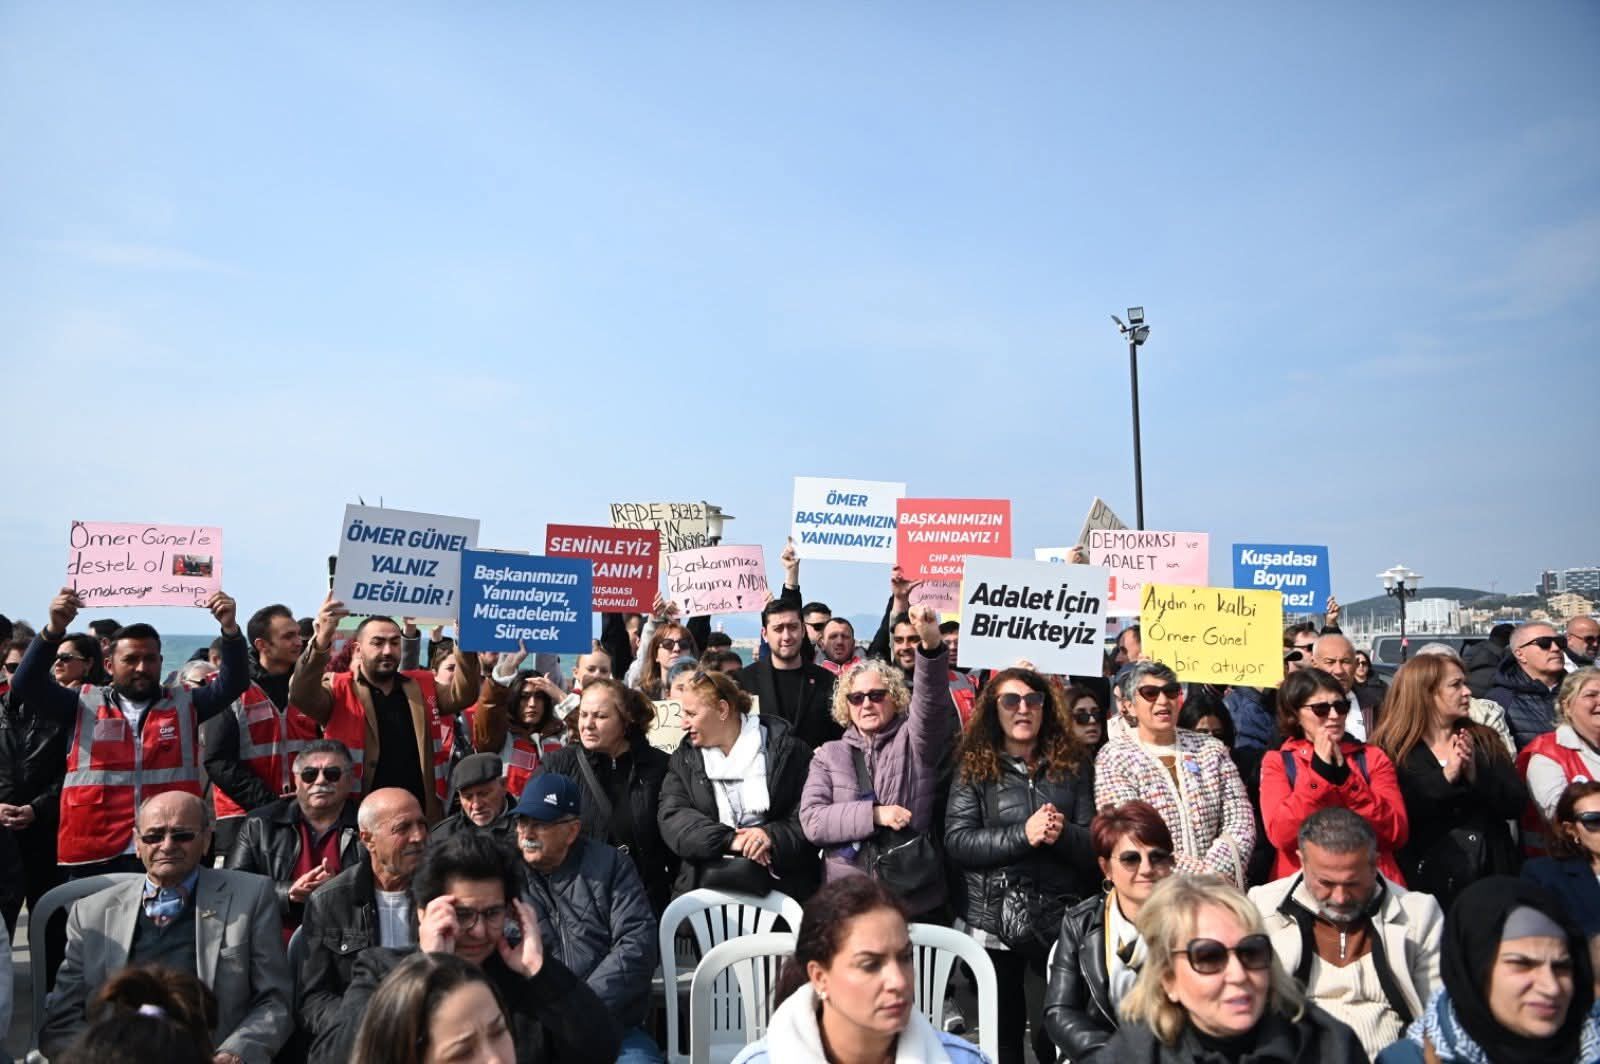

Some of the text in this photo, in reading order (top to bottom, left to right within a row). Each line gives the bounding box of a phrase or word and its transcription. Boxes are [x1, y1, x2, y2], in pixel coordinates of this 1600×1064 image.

[826, 490, 868, 507] ÖMER
[795, 511, 898, 529] BAŞKANIMIZIN
[900, 513, 1003, 528] BAŞKANIMIZIN
[70, 522, 138, 549] Ömer
[347, 519, 468, 552] ÖMER GÜNEL
[549, 535, 653, 556] SENİNLEYİZ
[801, 531, 885, 549] YANINDAYIZ
[907, 531, 992, 543] YANINDAYIZ
[67, 551, 165, 575] destek ol
[371, 555, 440, 577] YALNIZ
[928, 554, 947, 562] CHP
[1102, 552, 1158, 570] ADALET
[1240, 549, 1318, 570] Kuşadası
[473, 564, 578, 586] Başkanımızın
[592, 562, 643, 579] KANIM
[920, 565, 965, 576] İL BAŞKA
[1253, 569, 1307, 590] Boyun
[352, 580, 444, 606] DEĞİLDİR
[482, 584, 570, 607] Yanındayız,
[592, 586, 633, 596] UŞADASI
[968, 582, 1054, 610] Adalet
[1055, 584, 1100, 620] İçin
[473, 603, 578, 622] Mücadelemiz
[592, 598, 638, 608] AŞKANLIĞI
[494, 623, 560, 641] Sürecek
[971, 613, 1097, 650] Birlikteyiz
[1174, 650, 1200, 672] bir
